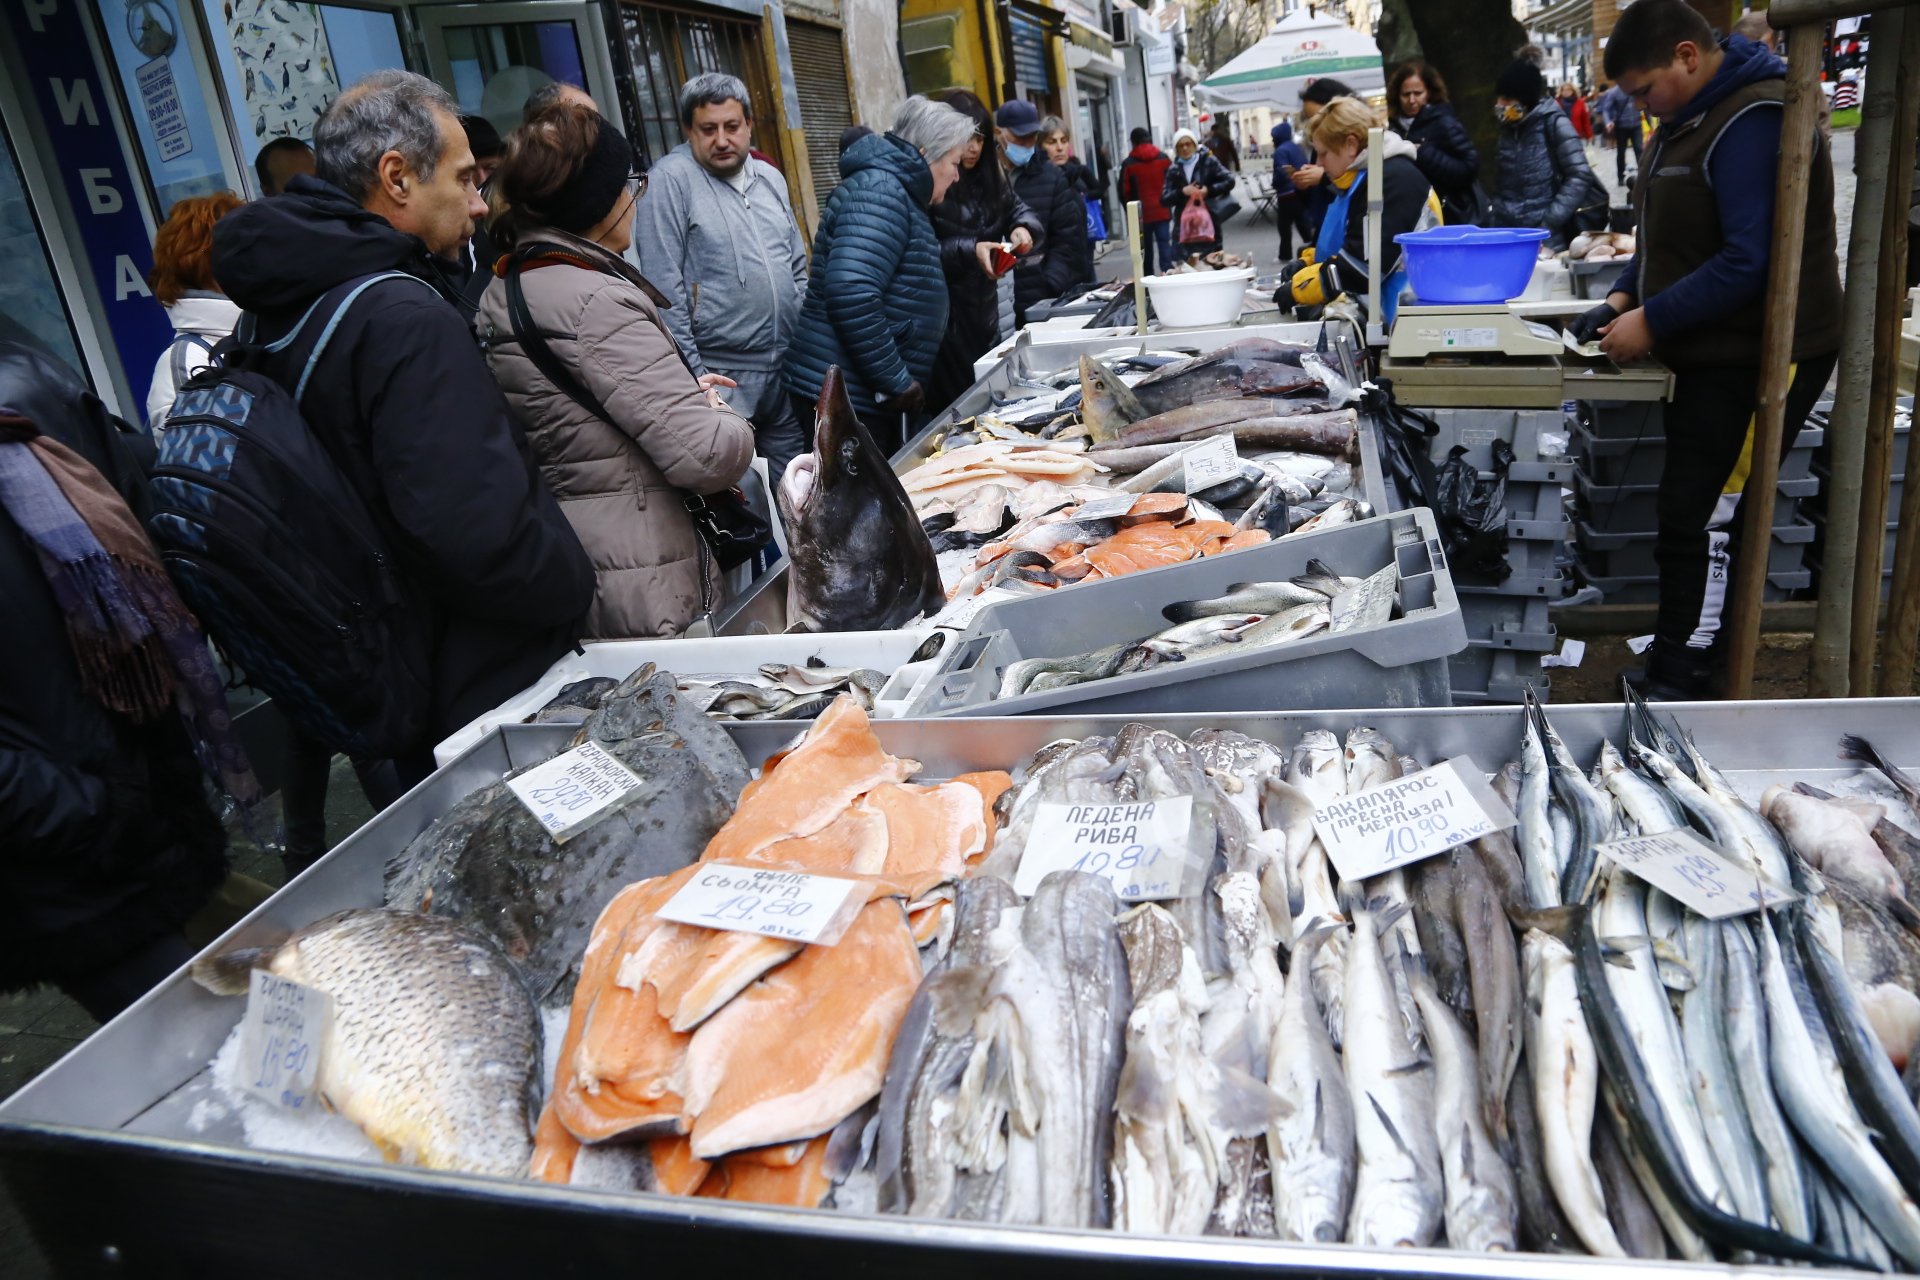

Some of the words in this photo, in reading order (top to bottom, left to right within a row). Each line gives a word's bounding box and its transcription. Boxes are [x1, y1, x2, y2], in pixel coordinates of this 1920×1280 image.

[22, 0, 153, 301] РИБА
[566, 762, 615, 800] КАЛКАН
[577, 743, 638, 790] ЧЕРНОМОРСКИ
[1066, 802, 1156, 826] ЛЕДЕНА
[1316, 775, 1438, 824] БАКАЛЯРОС
[1075, 826, 1137, 844] РИБА
[1384, 814, 1449, 864] 10,90
[1608, 837, 1688, 863] ЗАРГАН
[701, 873, 801, 898] СЬОМГА
[753, 870, 811, 886] ФИЛЕ
